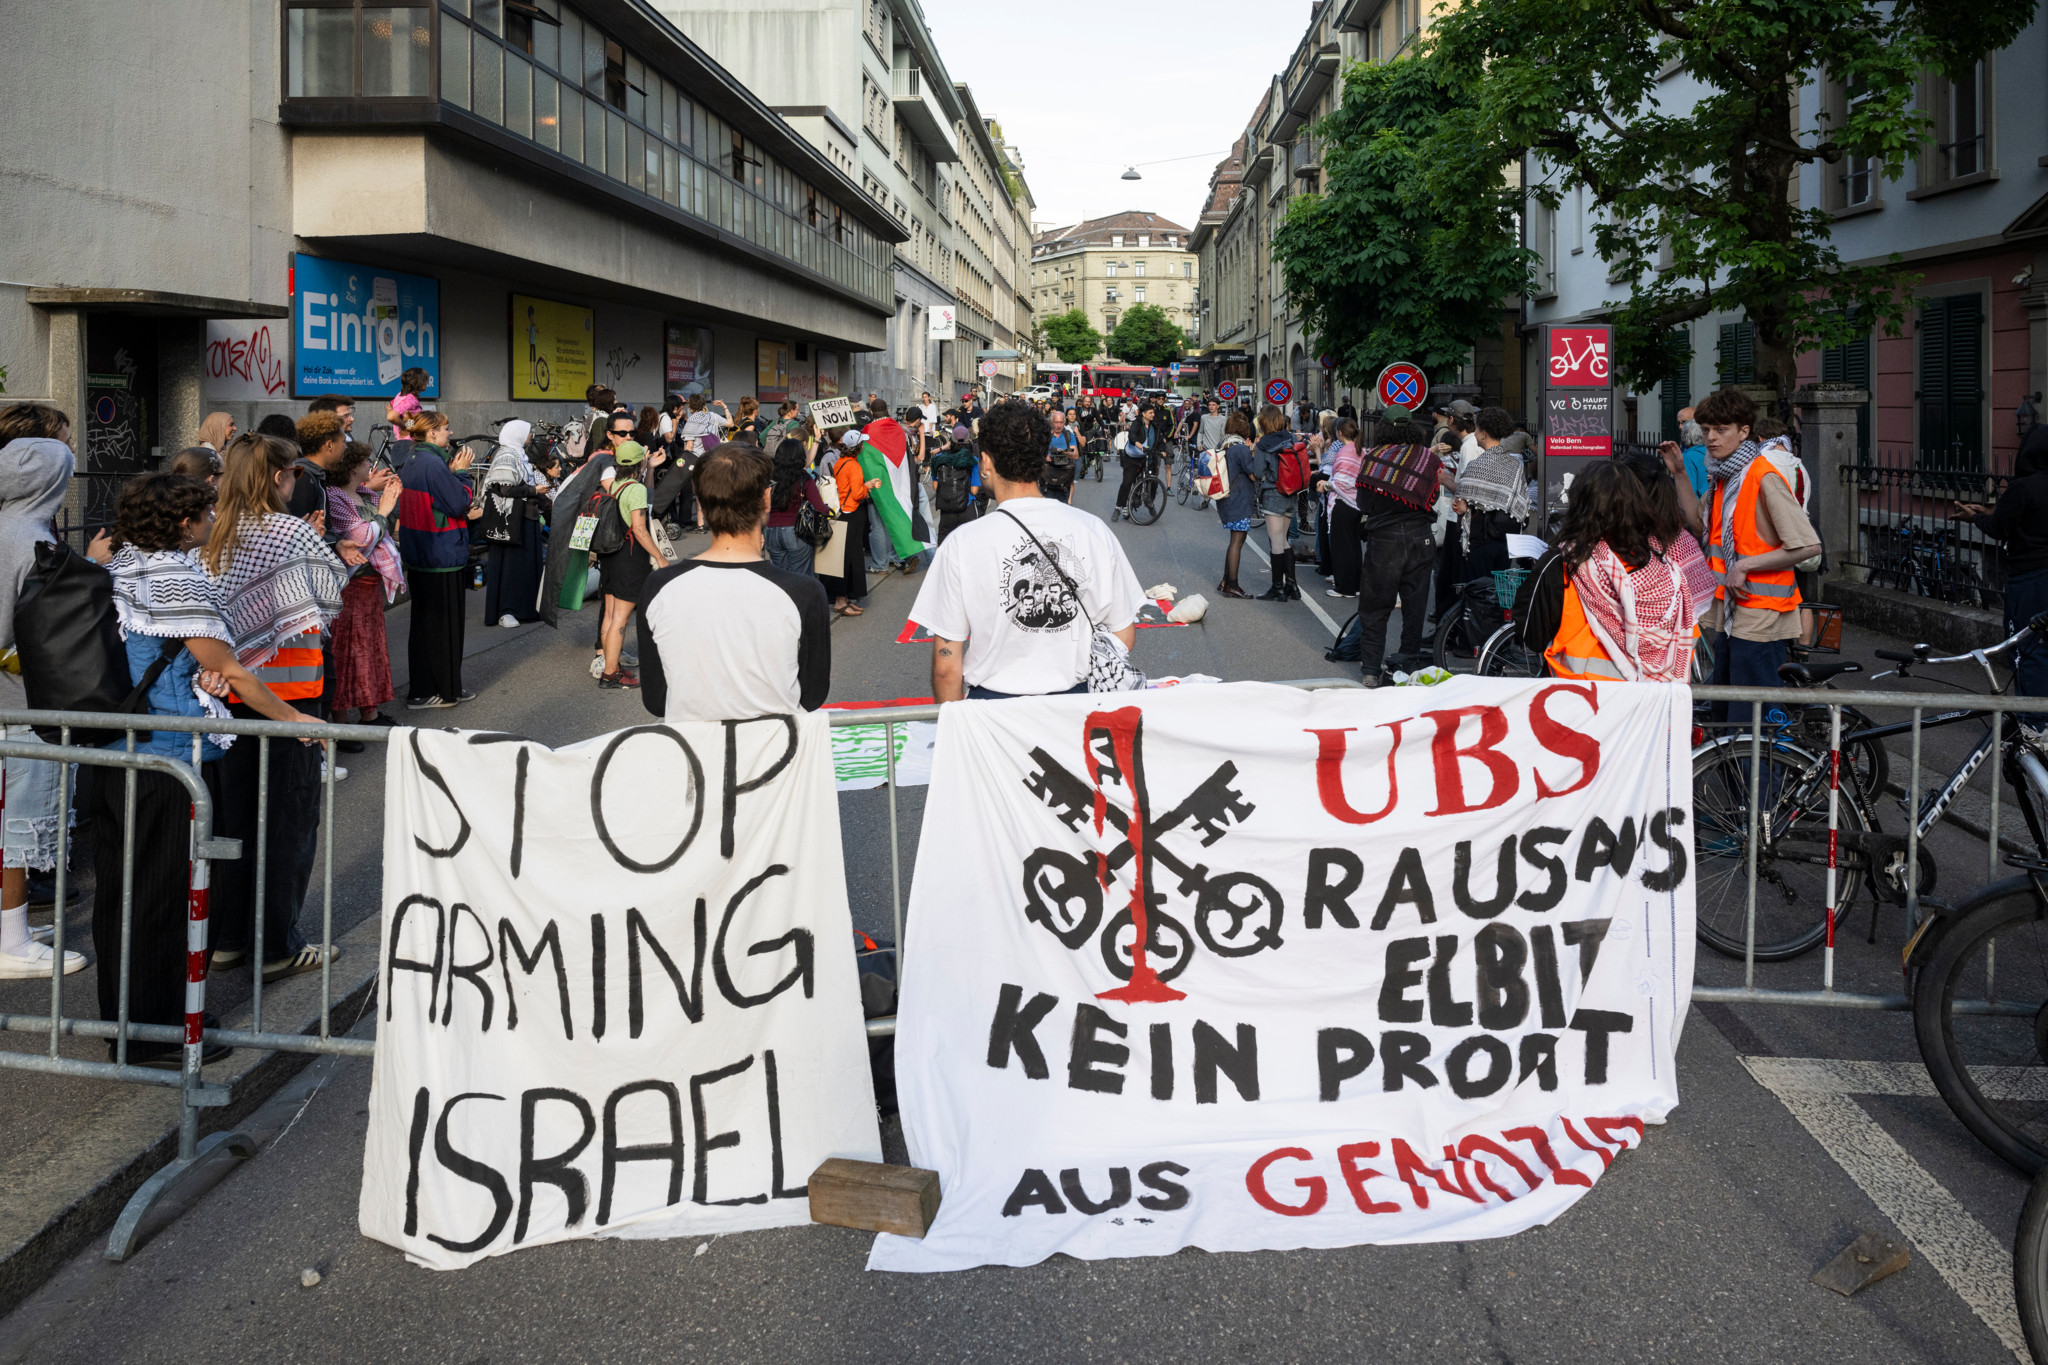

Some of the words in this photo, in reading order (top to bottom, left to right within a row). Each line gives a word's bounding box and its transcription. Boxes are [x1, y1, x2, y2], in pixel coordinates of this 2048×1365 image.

[303, 291, 434, 358] Einfach
[303, 365, 313, 373] Hol
[314, 365, 322, 374] dir
[303, 376, 318, 384] deine
[318, 376, 332, 385] Bank
[339, 377, 366, 387] kompliziert
[366, 378, 375, 386] ist.
[811, 398, 849, 411] CEASEFIRE
[1044, 624, 1071, 634] INTIFADA
[409, 712, 799, 880] STOP
[1302, 682, 1600, 825] UBS
[1917, 749, 1985, 840] carraro
[1302, 825, 1573, 930] RAUS
[386, 863, 815, 1043] ARMING
[1377, 917, 1613, 1031] ELBIT
[986, 983, 1261, 1104] KEIN
[404, 1049, 809, 1254] ISRAEL
[1001, 1161, 1192, 1218] AUS
